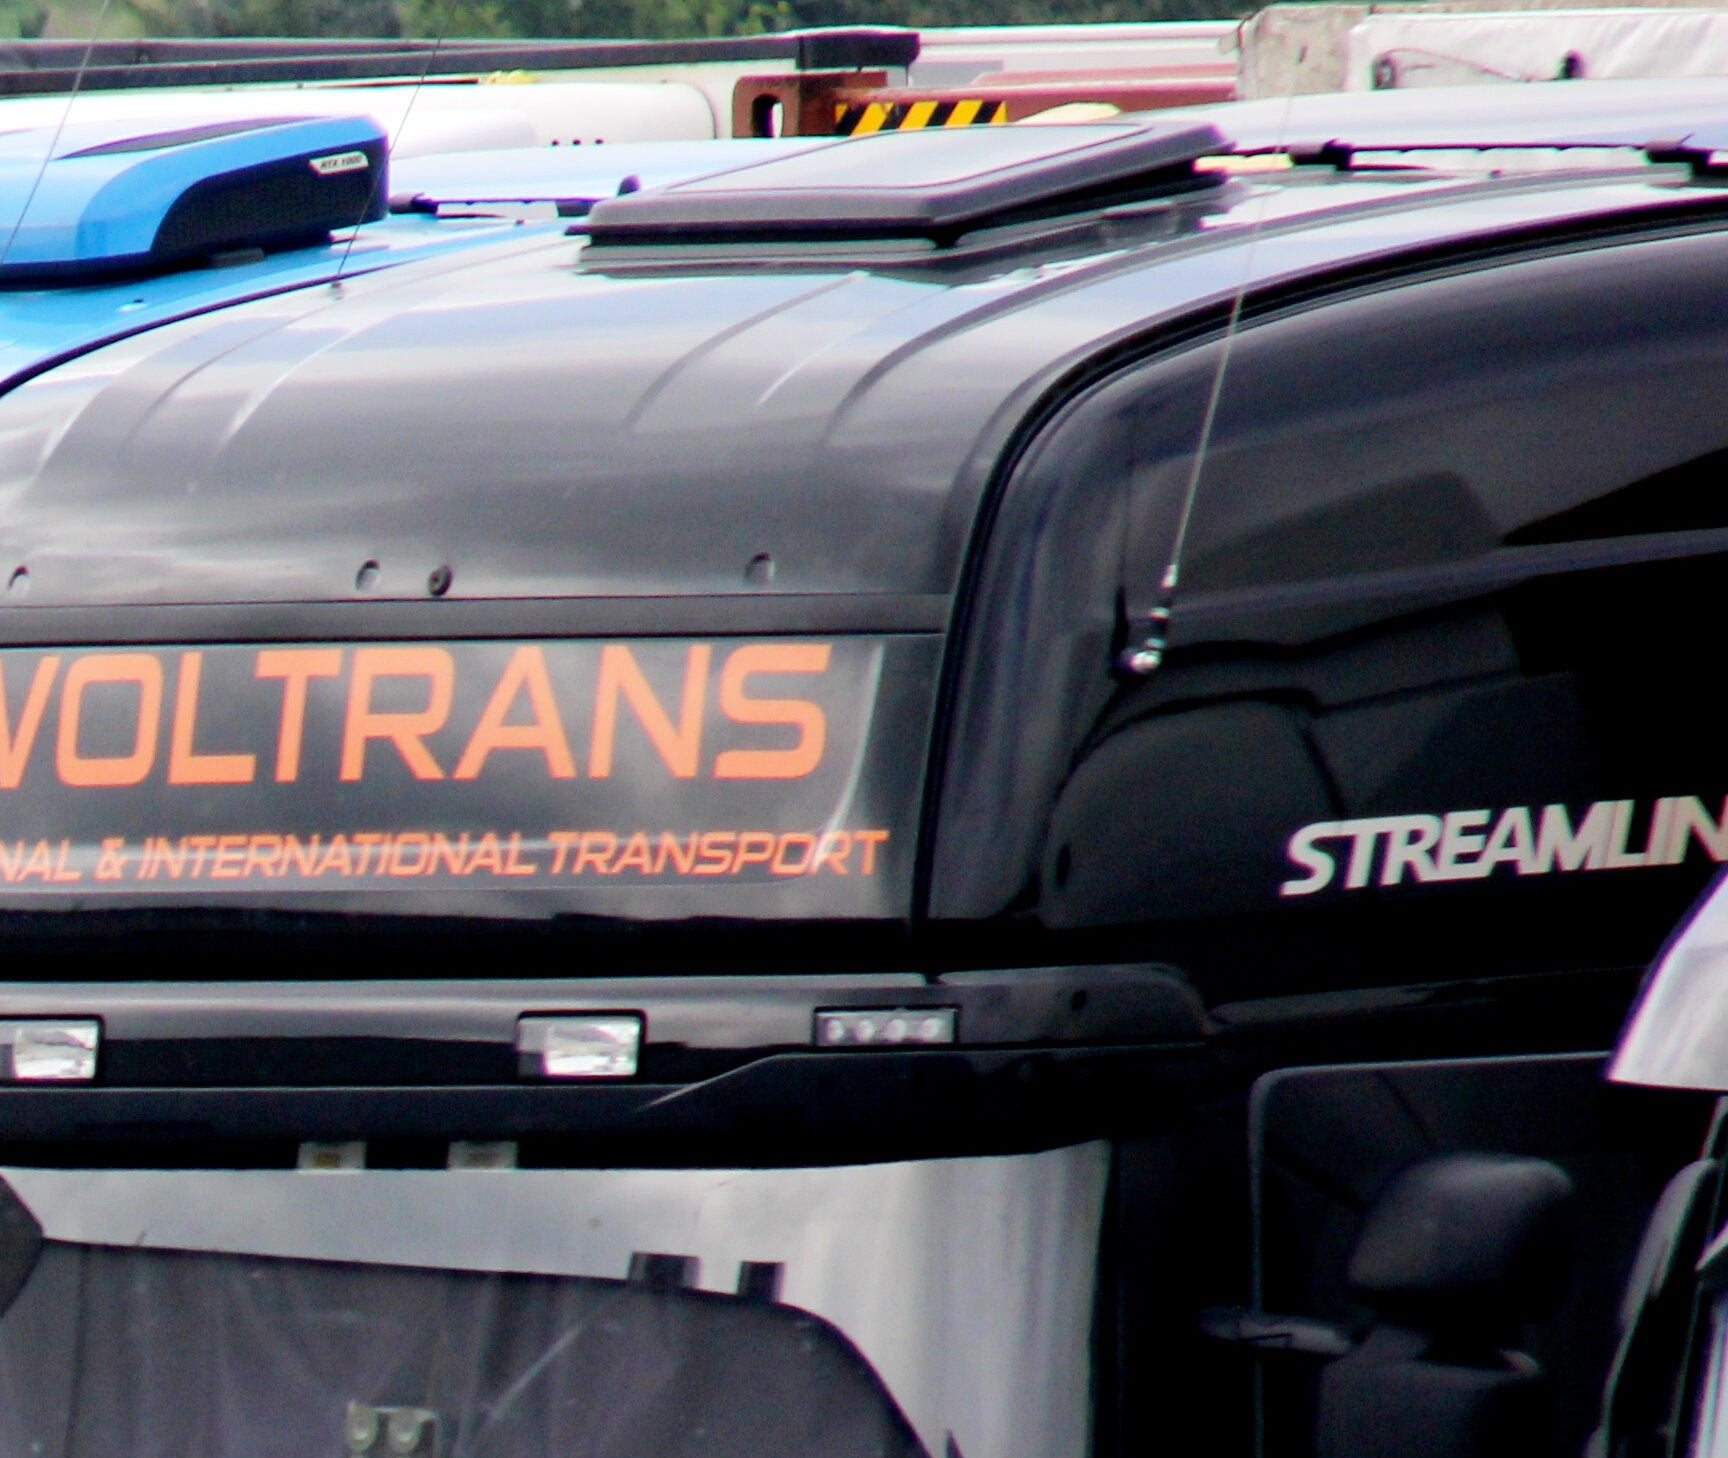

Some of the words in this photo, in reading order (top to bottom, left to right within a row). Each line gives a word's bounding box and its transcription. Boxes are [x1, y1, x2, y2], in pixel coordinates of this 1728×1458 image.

[94, 837, 126, 878] &
[137, 831, 538, 878] INTERNATIONAL
[548, 829, 889, 876] TRANSPORT
